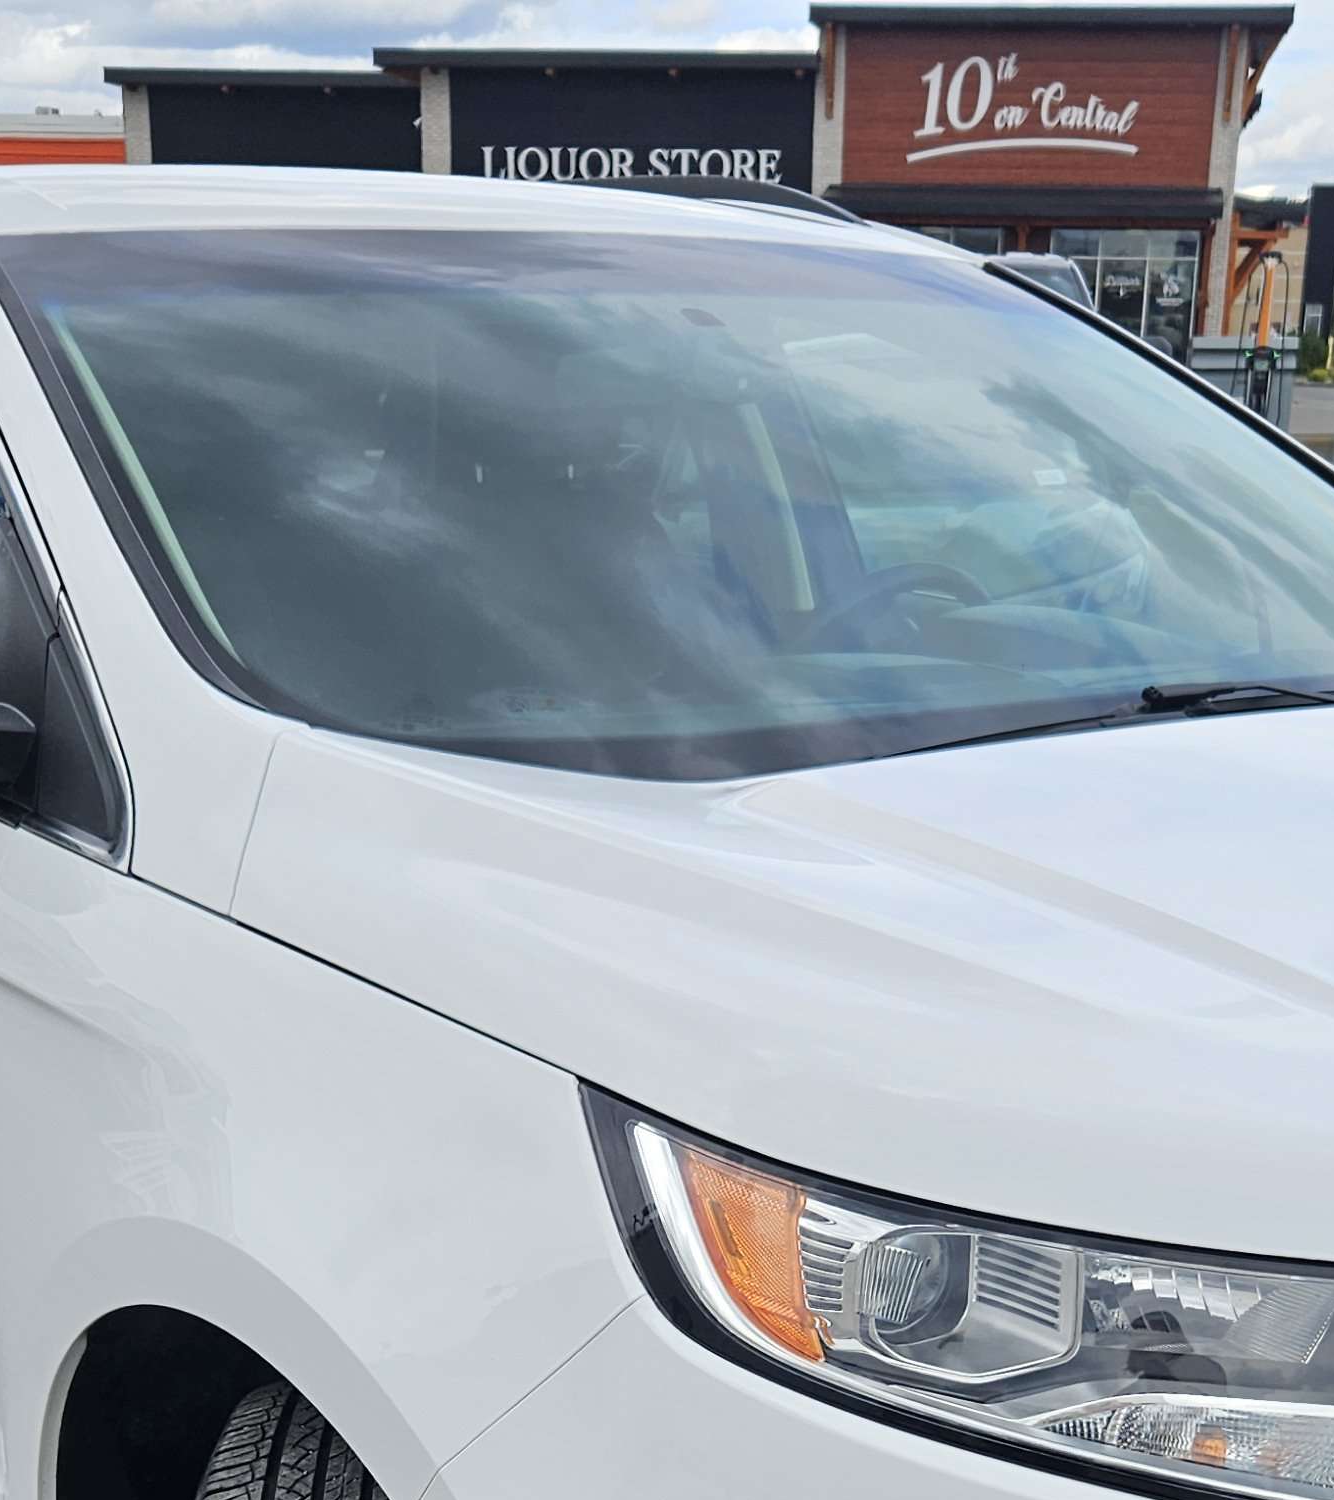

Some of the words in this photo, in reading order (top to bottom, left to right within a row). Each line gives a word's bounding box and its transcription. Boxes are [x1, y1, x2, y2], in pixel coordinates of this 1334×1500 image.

[994, 105, 1030, 130] on
[1031, 82, 1140, 136] Central
[647, 148, 783, 185] STORE
